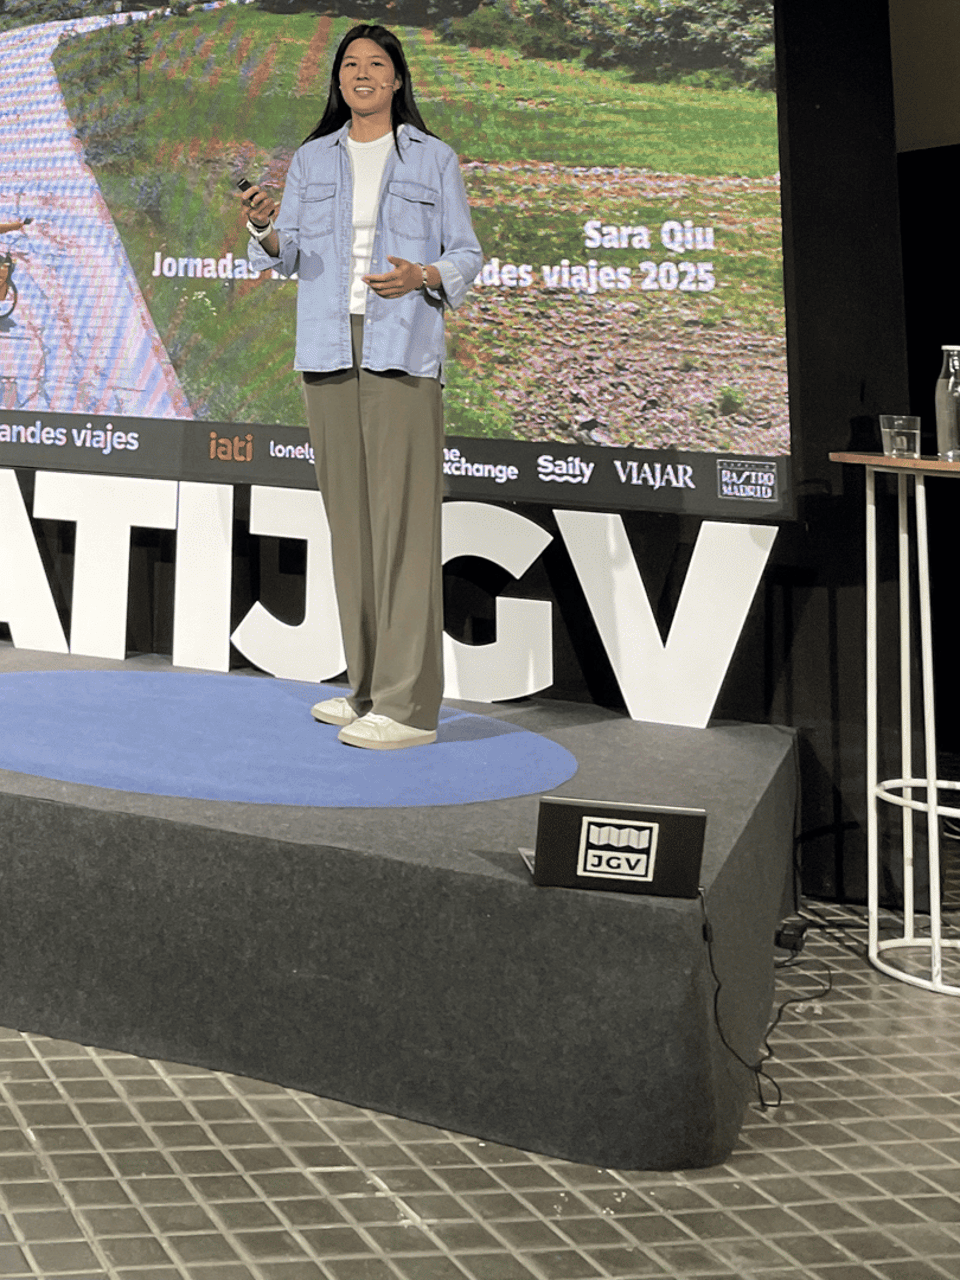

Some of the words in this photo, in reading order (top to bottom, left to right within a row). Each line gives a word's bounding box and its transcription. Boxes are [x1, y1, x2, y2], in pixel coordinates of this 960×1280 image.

[584, 220, 651, 249] Sara
[660, 220, 715, 253] Qiu
[541, 259, 632, 294] viajes
[639, 261, 716, 292] 2025
[72, 422, 140, 455] viajes
[209, 431, 254, 462] iati
[443, 456, 519, 484] xchange
[537, 454, 595, 484] Saily
[613, 459, 696, 490] VIAJAR
[721, 483, 773, 499] MADRID
[590, 854, 642, 871] JGV
